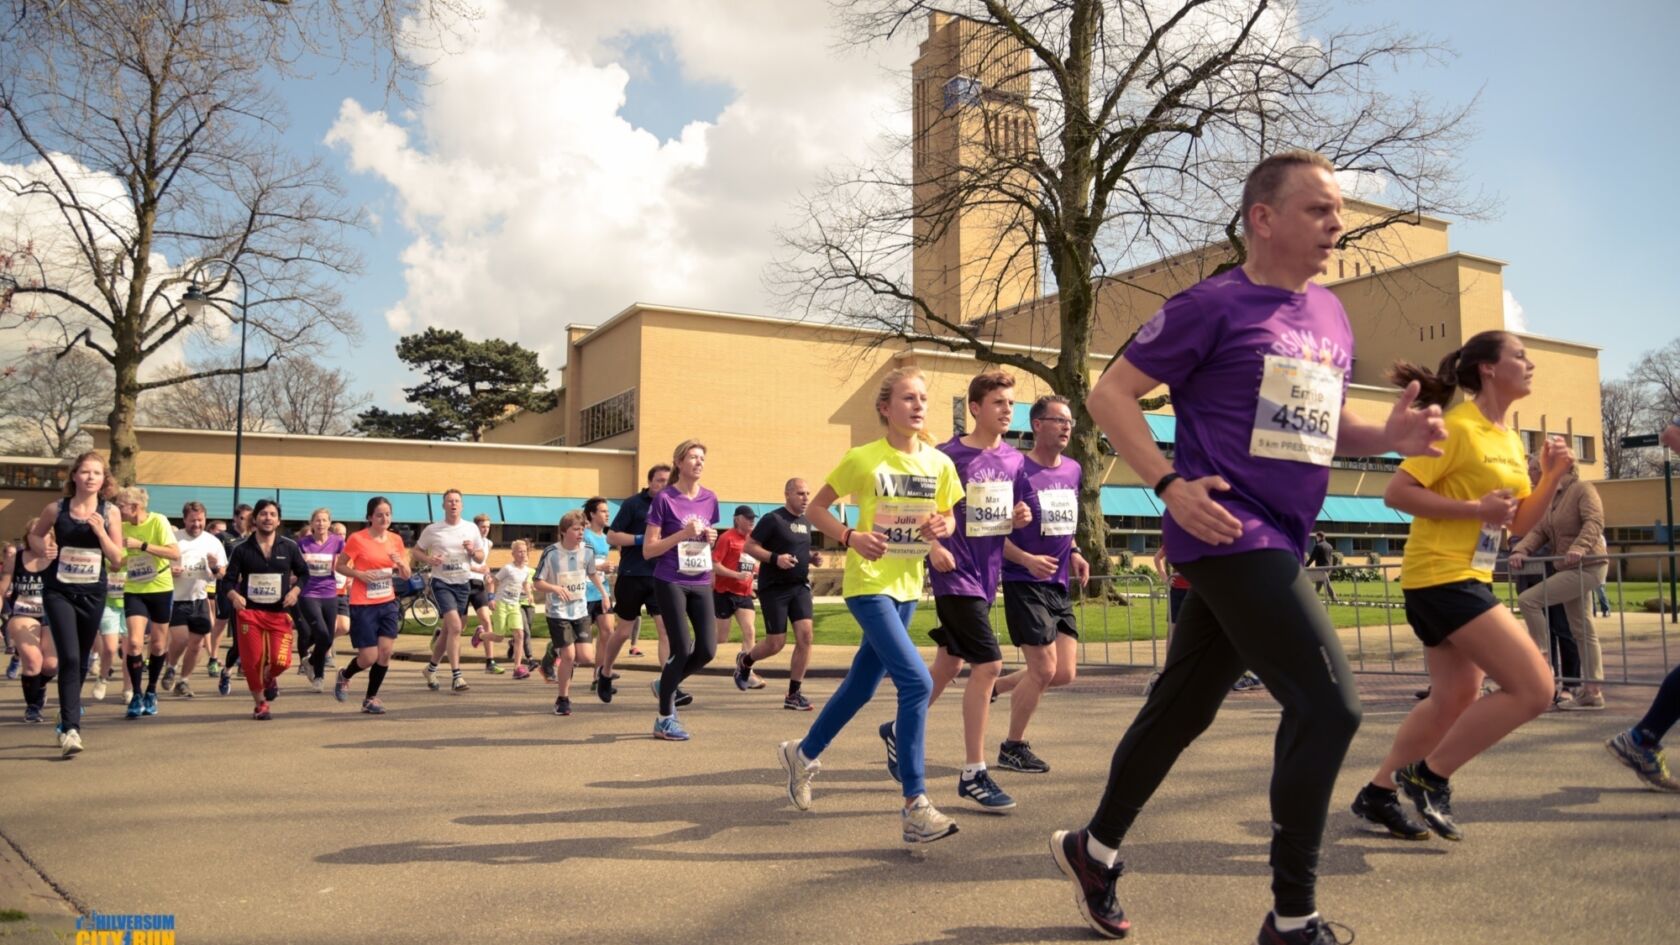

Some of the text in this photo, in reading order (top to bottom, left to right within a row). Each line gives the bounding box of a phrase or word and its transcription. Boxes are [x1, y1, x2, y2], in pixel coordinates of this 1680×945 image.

[1271, 404, 1331, 435] 4556
[975, 505, 1008, 521] 3844
[1048, 509, 1074, 522] 3843
[894, 515, 917, 525] Julia
[883, 527, 924, 543] 4312
[64, 563, 95, 574] 4774
[684, 557, 707, 569] 4021
[252, 586, 276, 596] 4775
[277, 633, 293, 666] GUINEE
